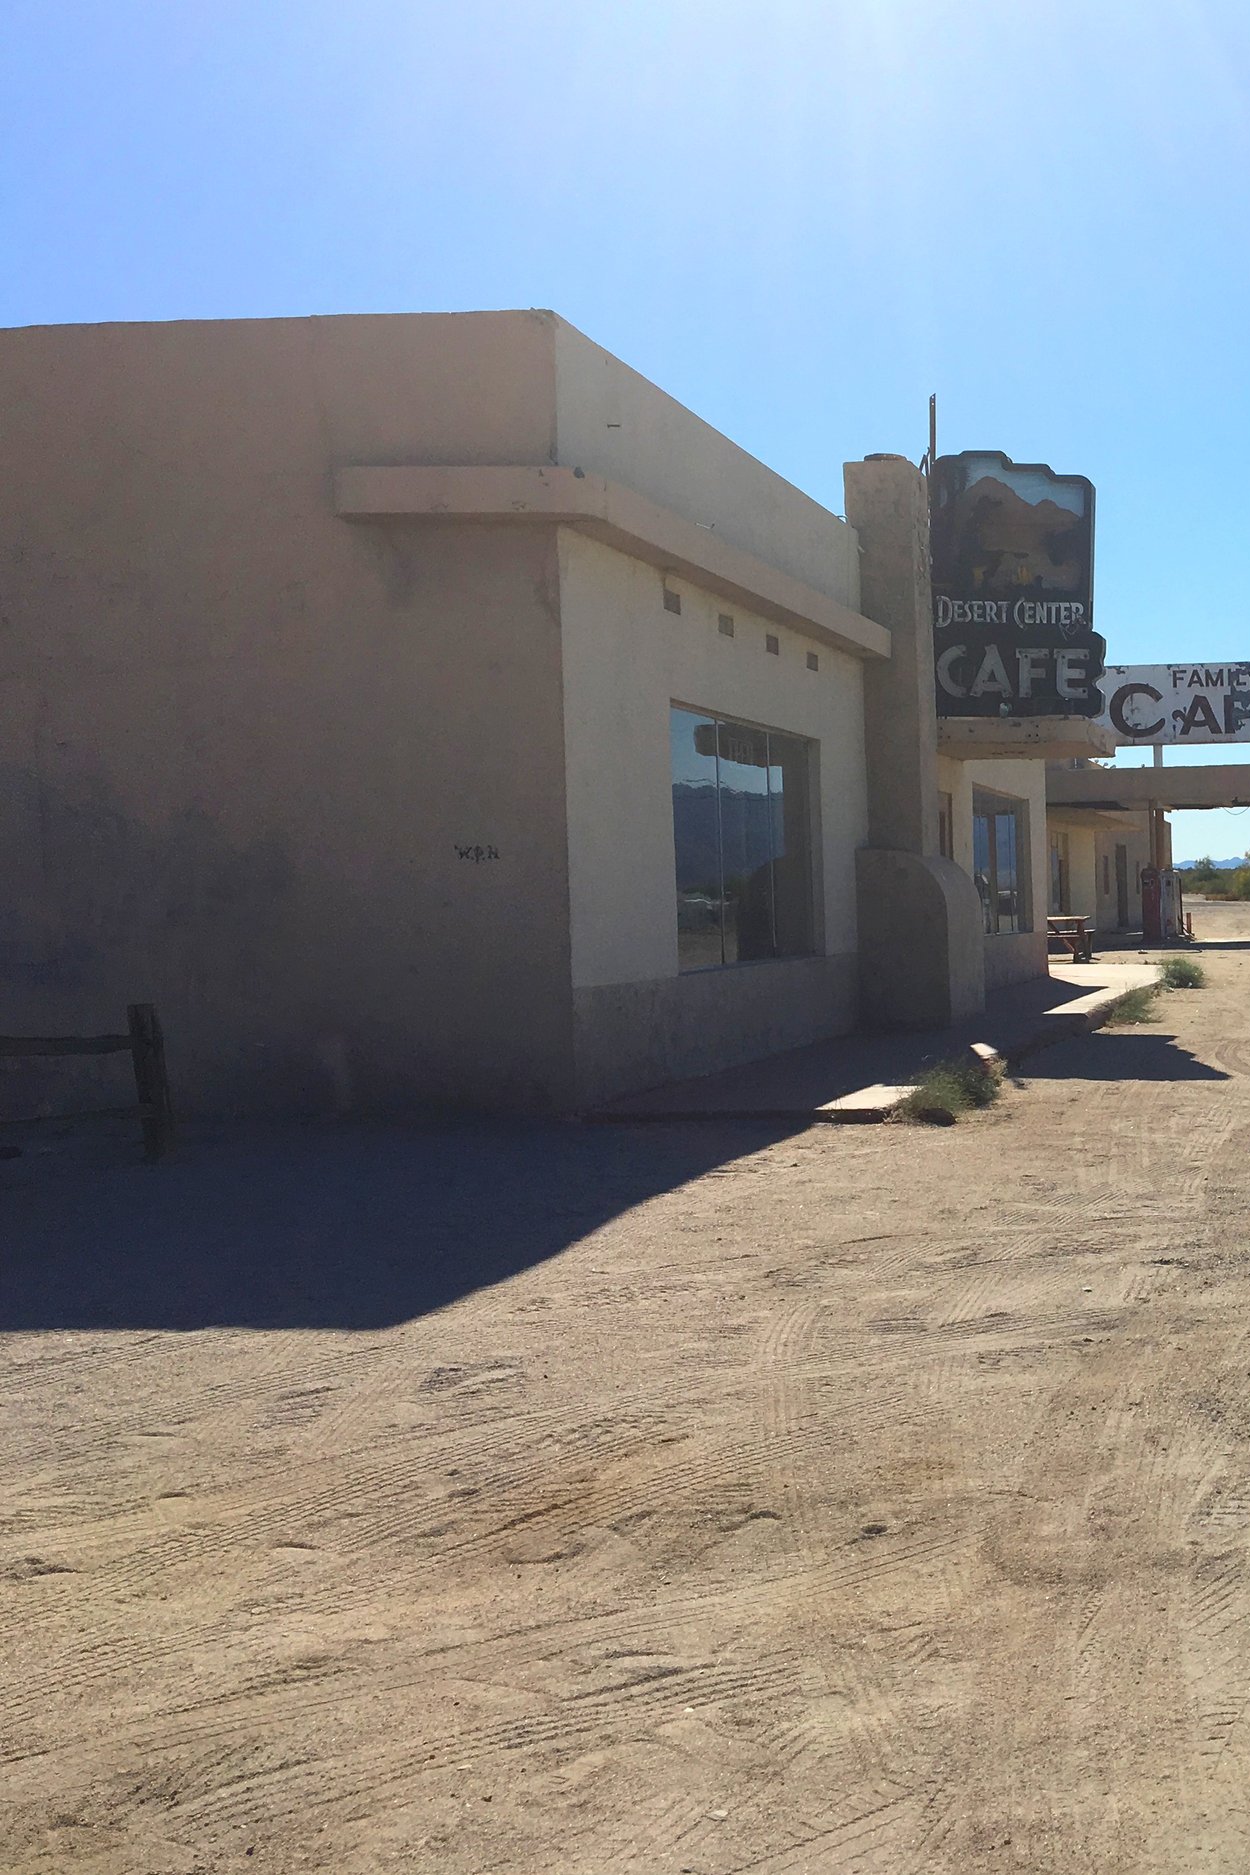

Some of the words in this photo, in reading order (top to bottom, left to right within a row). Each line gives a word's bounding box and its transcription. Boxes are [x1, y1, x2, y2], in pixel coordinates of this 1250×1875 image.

[935, 595, 1010, 628] DESERT
[1013, 596, 1087, 630] CENTER
[936, 644, 1090, 698] CAFE
